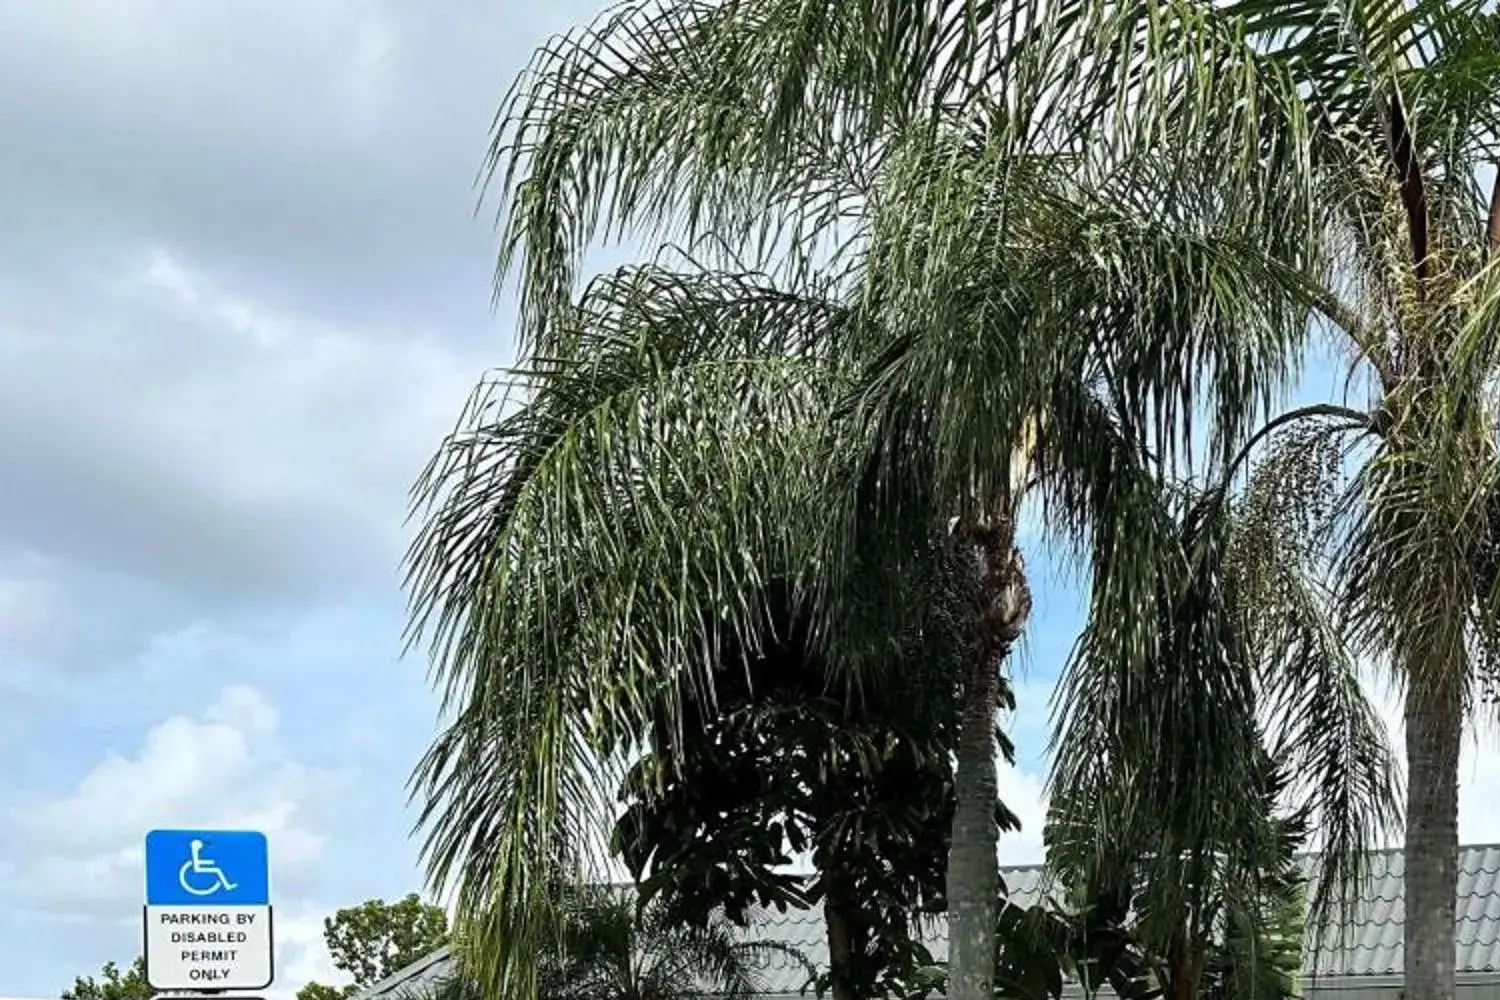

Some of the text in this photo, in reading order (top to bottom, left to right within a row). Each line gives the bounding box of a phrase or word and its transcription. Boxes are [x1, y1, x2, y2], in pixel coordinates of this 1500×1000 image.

[160, 913, 256, 924] PARKING BY
[171, 931, 247, 943] DISABLED
[181, 950, 238, 961] PERMIT
[189, 968, 231, 980] ONLY
